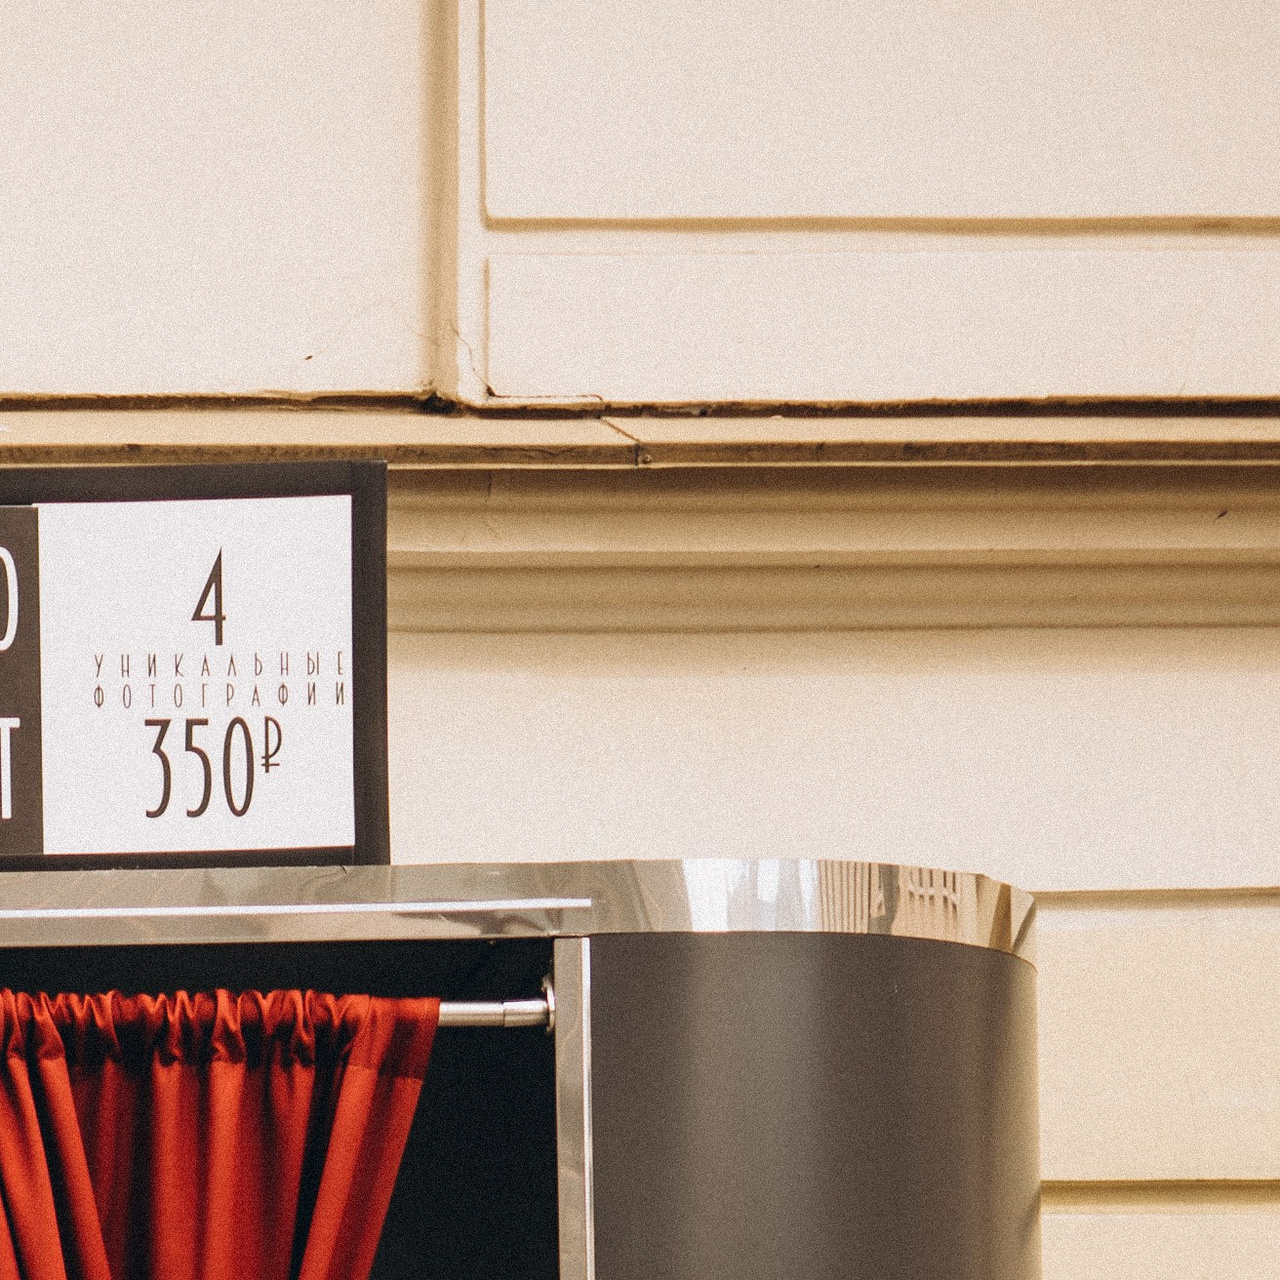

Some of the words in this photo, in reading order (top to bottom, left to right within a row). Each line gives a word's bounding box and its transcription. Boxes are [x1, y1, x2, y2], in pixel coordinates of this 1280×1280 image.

[191, 546, 228, 647] 4
[94, 651, 345, 678] УНИКАЛЬНЫЕ
[93, 681, 345, 709] ФОТОГРАФИИ
